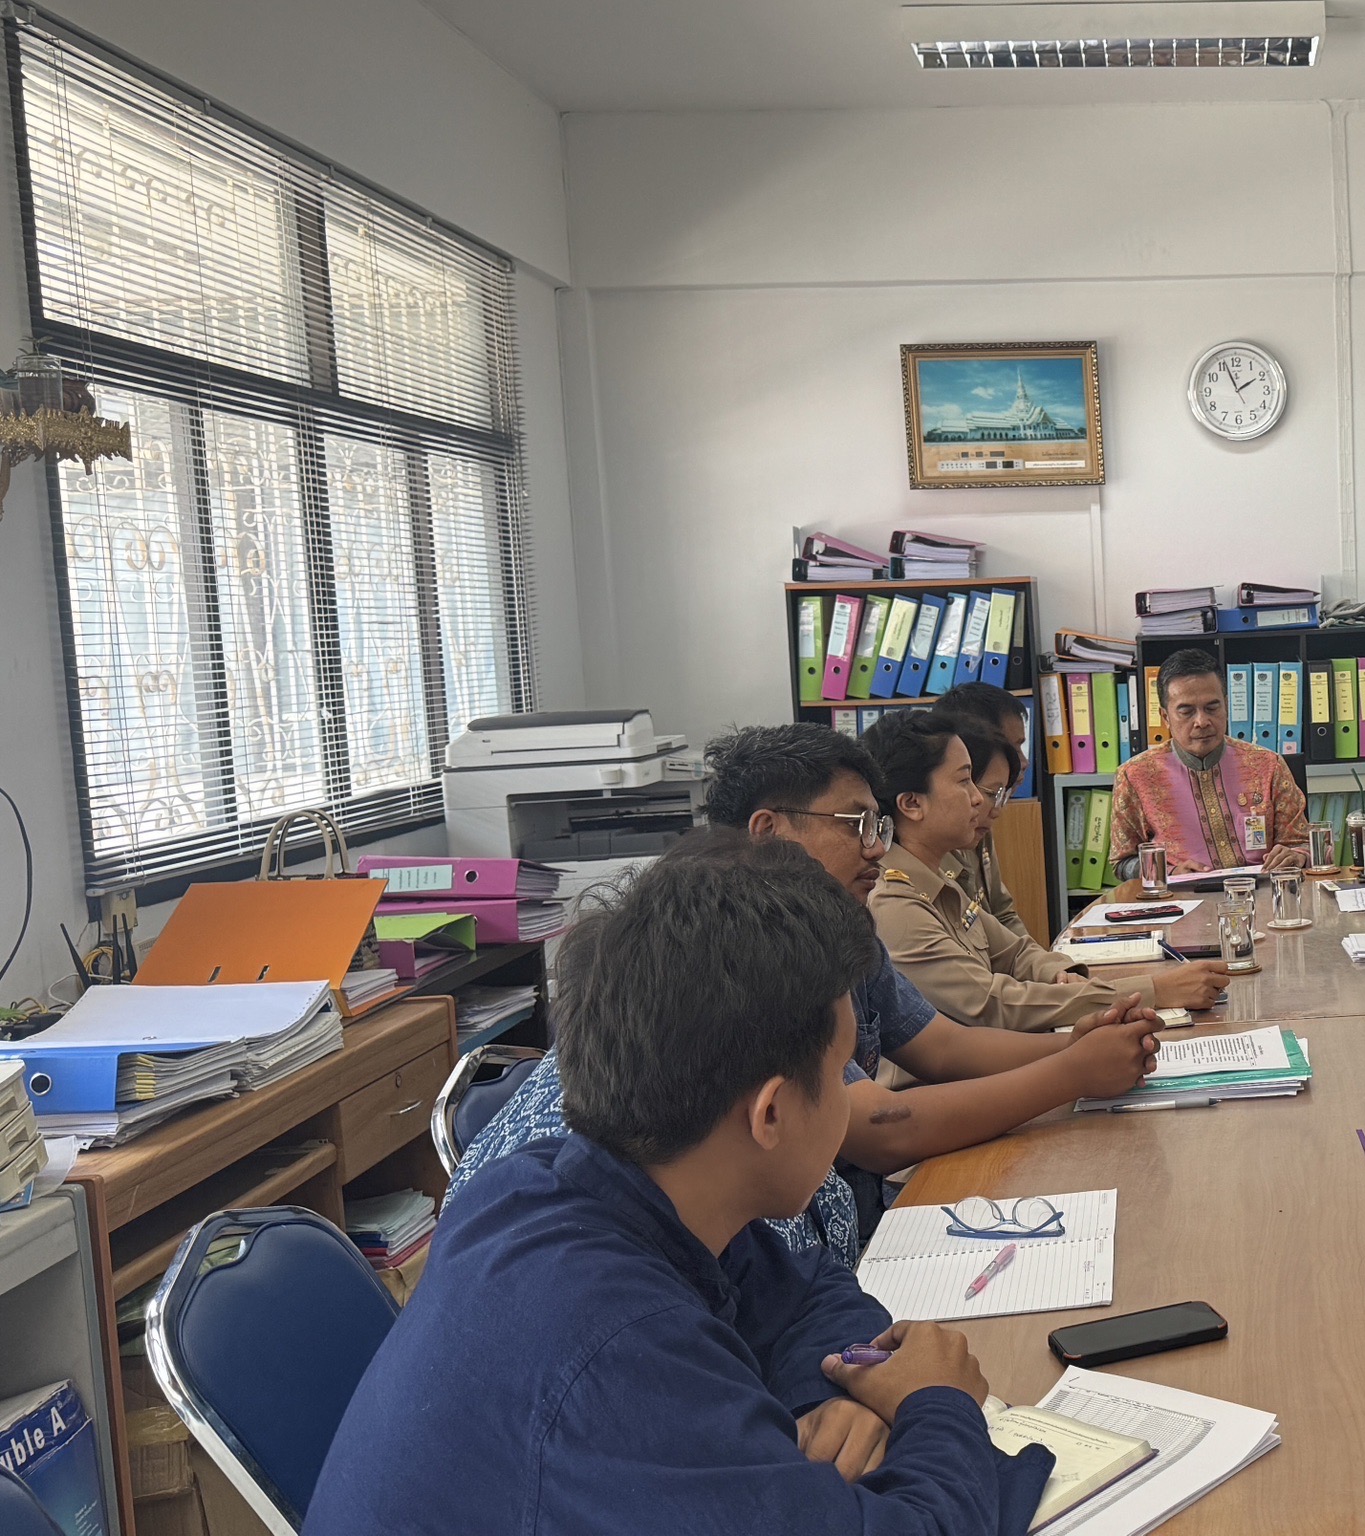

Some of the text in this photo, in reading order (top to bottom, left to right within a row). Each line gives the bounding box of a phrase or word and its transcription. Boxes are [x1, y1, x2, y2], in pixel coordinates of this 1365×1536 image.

[1231, 356, 1242, 368] 12
[1208, 372, 1219, 383] 10
[1258, 371, 1266, 382] 2
[1204, 386, 1212, 397] 9
[1262, 385, 1271, 396] 3
[1209, 401, 1217, 411] 8
[1259, 399, 1267, 410] 4
[1221, 411, 1229, 421] 7
[1235, 414, 1243, 425] 6
[1249, 409, 1257, 420] 5
[50, 1405, 67, 1437] A
